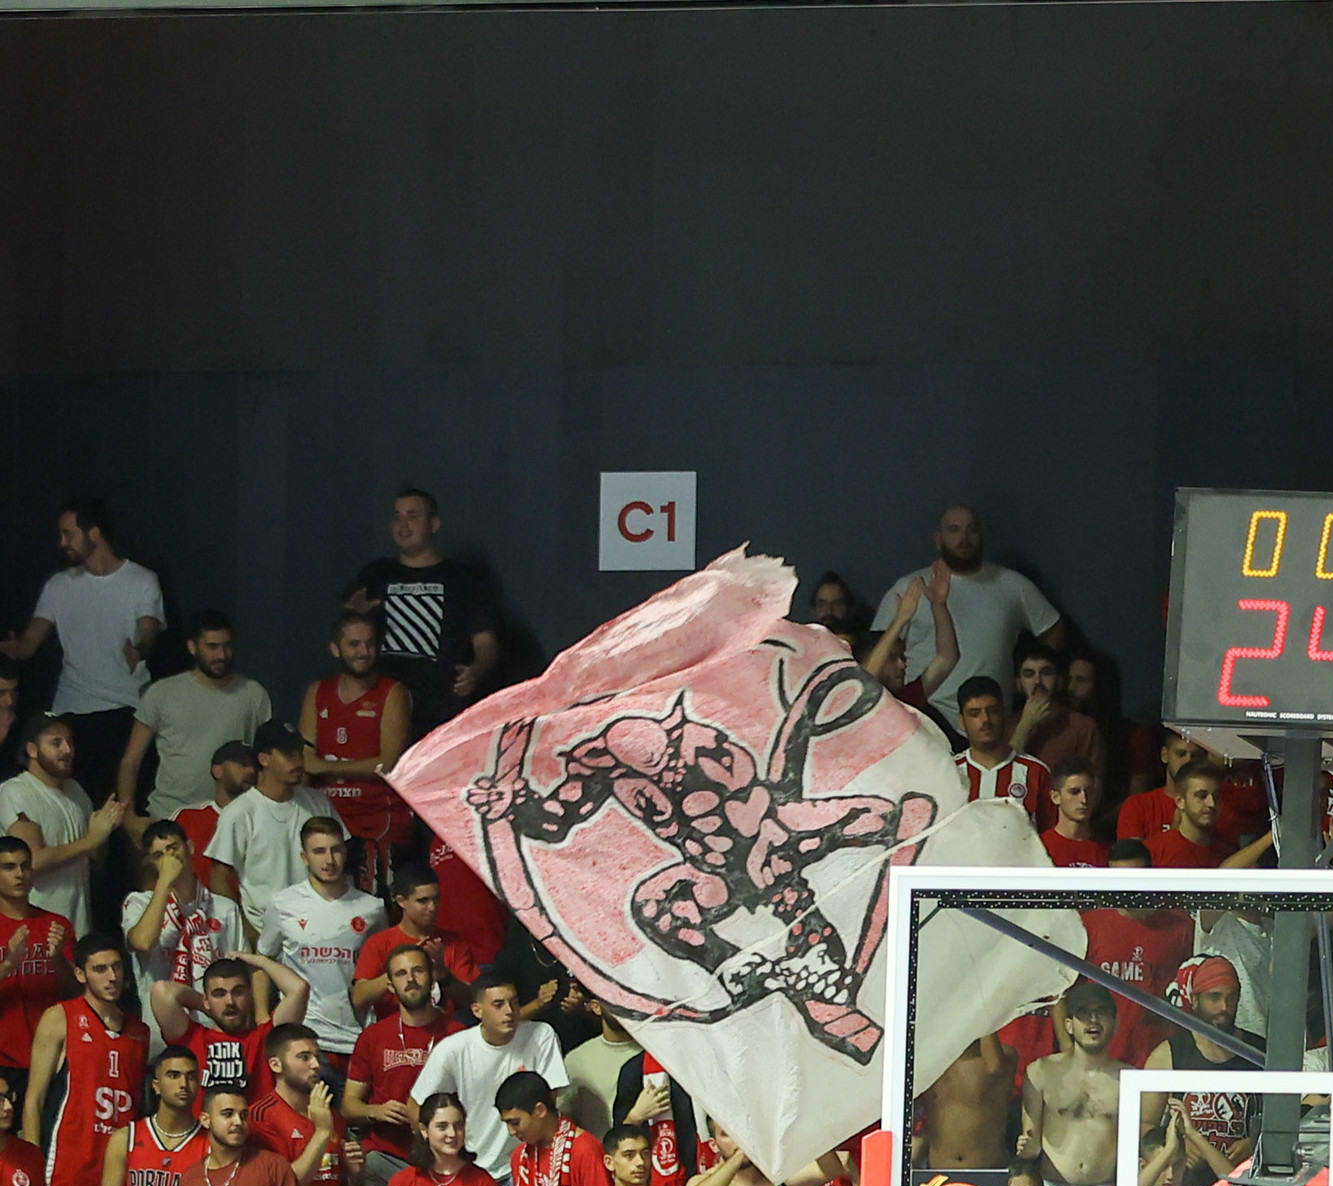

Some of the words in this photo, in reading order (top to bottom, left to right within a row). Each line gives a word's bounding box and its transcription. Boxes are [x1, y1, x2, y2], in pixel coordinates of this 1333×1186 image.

[617, 500, 677, 543] C1
[1241, 510, 1288, 579] 0
[301, 946, 352, 959] הכשרה
[1100, 961, 1145, 982] SAME
[94, 1087, 133, 1122] SP
